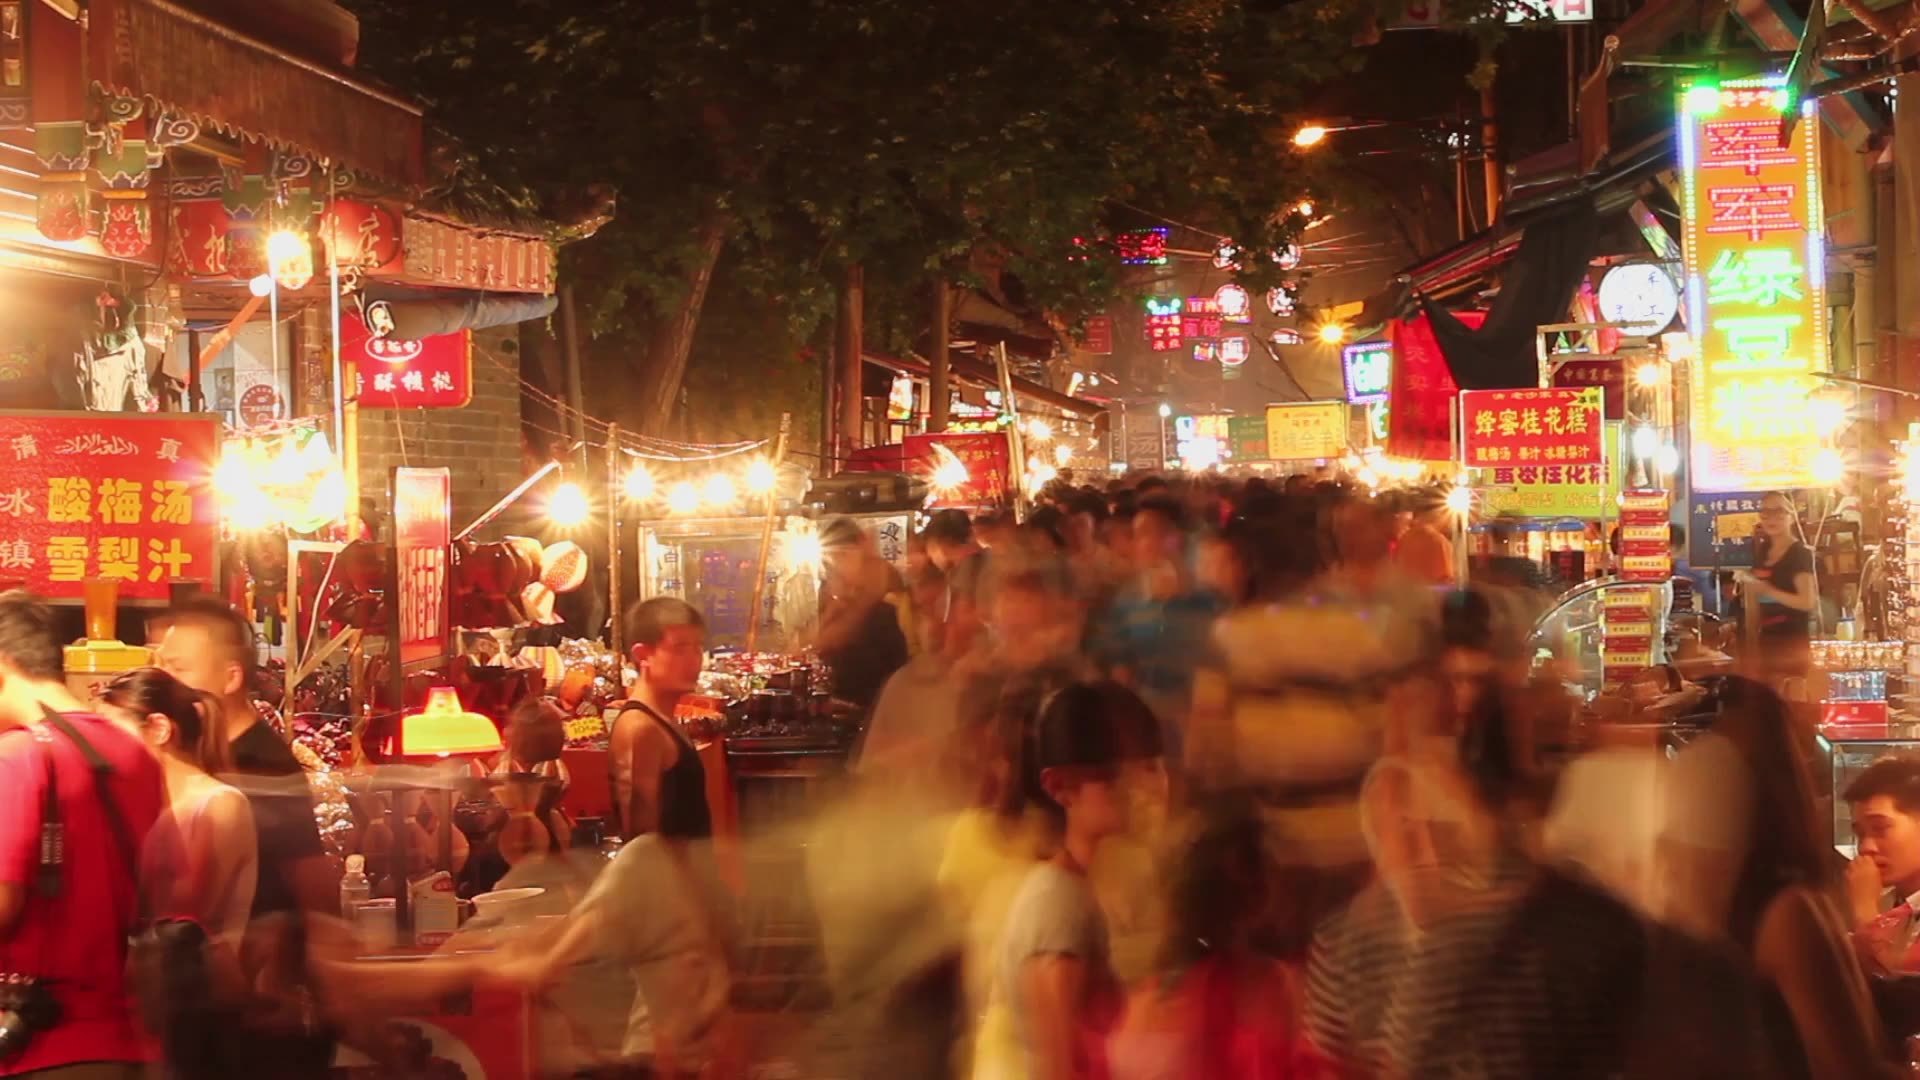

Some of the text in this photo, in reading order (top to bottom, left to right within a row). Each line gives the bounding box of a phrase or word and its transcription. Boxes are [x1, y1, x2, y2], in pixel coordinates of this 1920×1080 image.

[1475, 407, 1588, 437] 蜂蜜桂花糕
[11, 434, 39, 461] 清
[156, 437, 183, 463] 真
[47, 476, 193, 525] 酸梅汤
[46, 536, 193, 582] 雪梨汁
